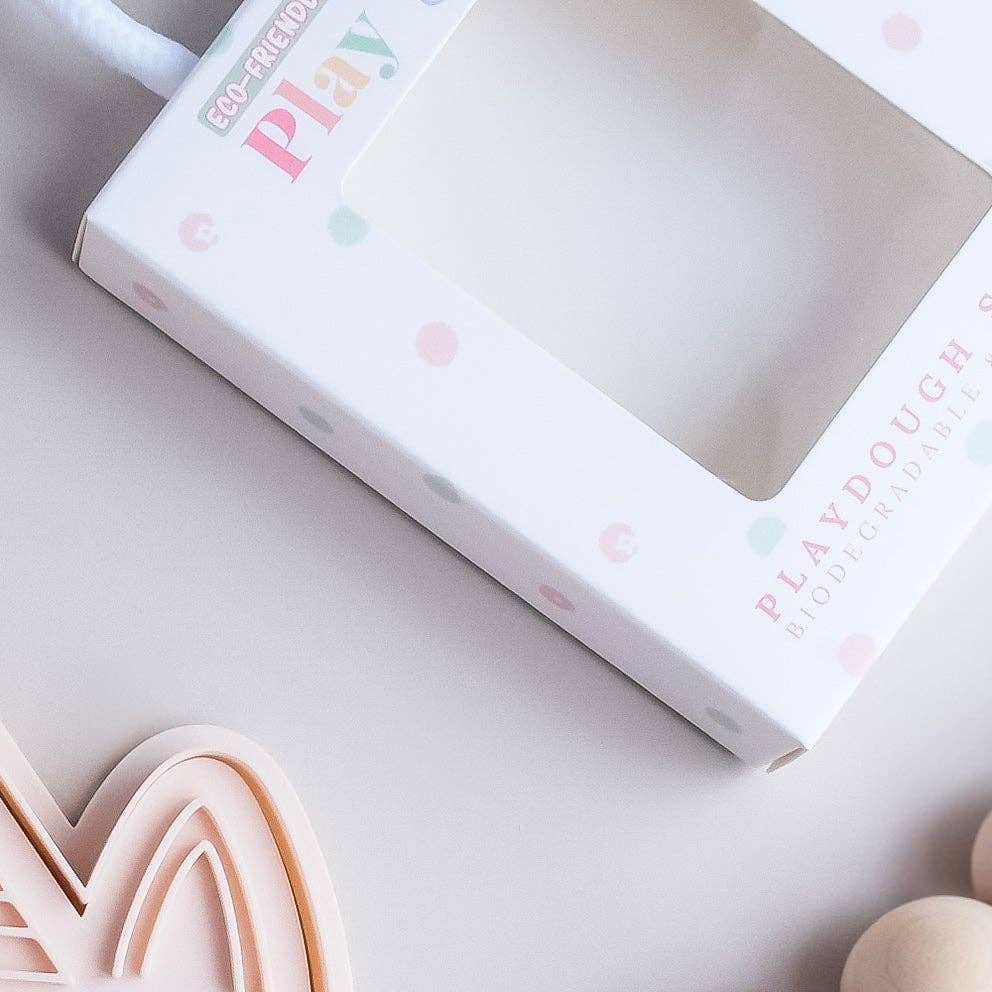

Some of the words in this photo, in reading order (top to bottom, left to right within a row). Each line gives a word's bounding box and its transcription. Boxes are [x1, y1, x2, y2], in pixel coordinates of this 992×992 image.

[240, 9, 400, 184] Play
[755, 338, 973, 622] PLAYDOUGH
[785, 383, 980, 639] BIODEGRADABLE
